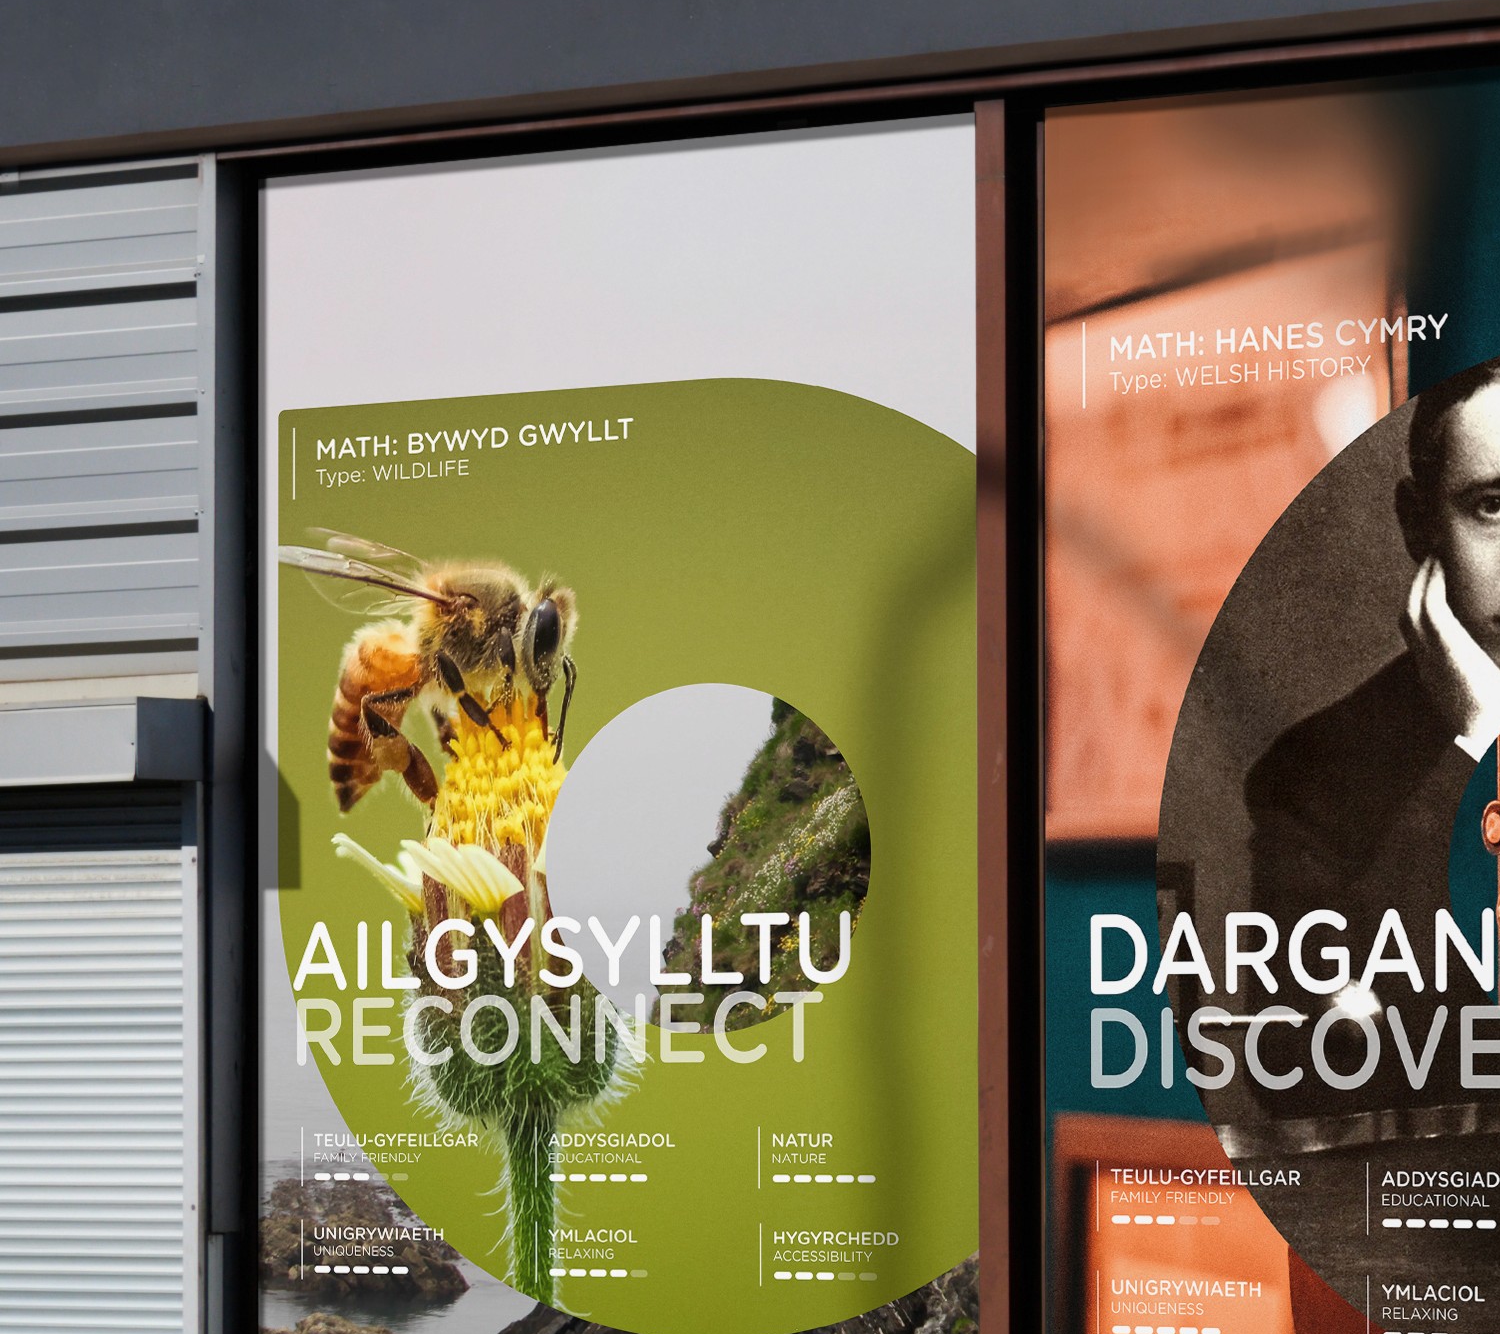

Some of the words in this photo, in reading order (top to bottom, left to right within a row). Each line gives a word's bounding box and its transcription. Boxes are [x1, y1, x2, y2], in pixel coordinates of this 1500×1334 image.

[1110, 331, 1204, 362] MATH:
[1217, 323, 1323, 355] HANES
[1336, 313, 1448, 346] CYMRY
[1109, 369, 1167, 394] Type:
[1175, 363, 1259, 388] WELSH
[1268, 355, 1371, 381] HISTORY
[317, 435, 398, 461] MATH:
[408, 427, 509, 455] BYWYD
[519, 418, 634, 448] GWYLLT
[316, 465, 366, 487] Type:
[372, 458, 469, 481] WILDLIFE
[294, 911, 851, 991] AILGYSYLLTU
[296, 991, 824, 1066] RECONNECT
[314, 1132, 479, 1148] TEULU-GYFEILLGAR
[549, 1132, 675, 1148] ADDYSGIADOL
[772, 1133, 833, 1148] NATUR
[314, 1152, 356, 1162] FAMILY
[361, 1151, 422, 1163] FRIENDLY
[549, 1151, 641, 1163] EDUCATIONAL
[772, 1152, 827, 1164] NATURE
[1111, 1167, 1301, 1186] TEULU-GYFEILLGAR
[1111, 1190, 1160, 1204] FAMILY
[1166, 1190, 1235, 1206] FRIENDLY
[1382, 1193, 1490, 1208] EDUCATIONAL
[314, 1226, 444, 1241] UNIGRYWIAETH
[549, 1228, 637, 1244] YMLACIOL
[773, 1229, 900, 1247] HYGYRCHEDD
[314, 1244, 394, 1257] UNIQUENESS
[549, 1247, 614, 1260] RELAXING
[773, 1249, 872, 1263] ACCESSIBILITY
[1111, 1278, 1261, 1297] UNIGRYWIAETH
[1382, 1283, 1486, 1303] YMLACIOL
[1111, 1300, 1204, 1316] UNIQUENESS
[1382, 1306, 1458, 1321] RELAXING
